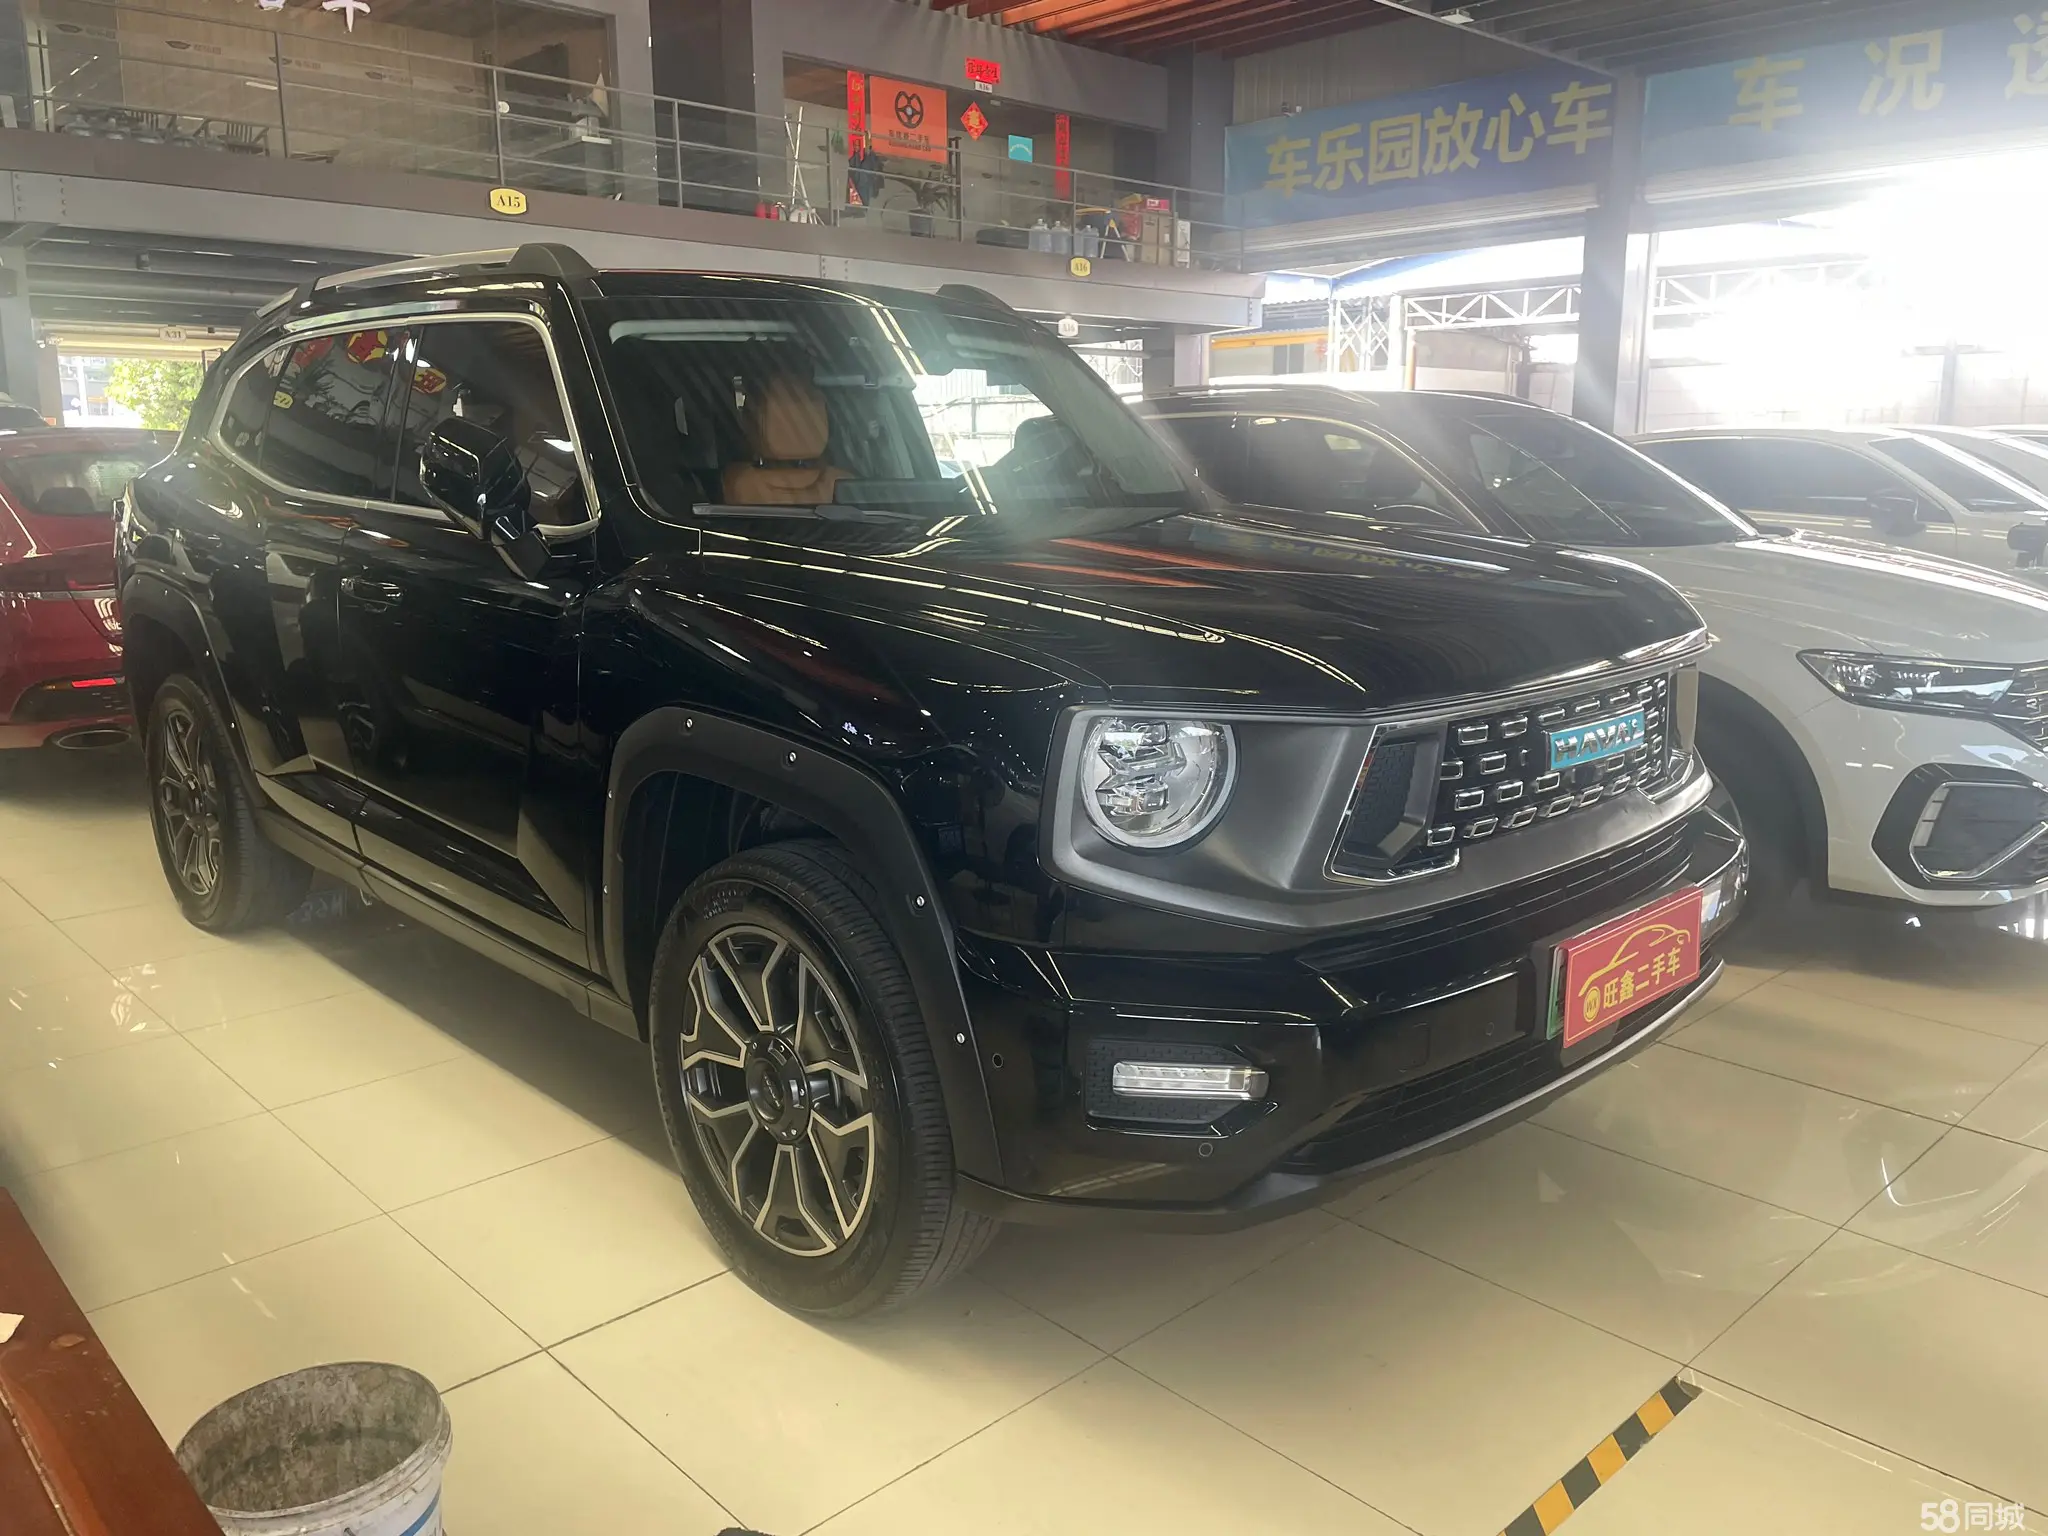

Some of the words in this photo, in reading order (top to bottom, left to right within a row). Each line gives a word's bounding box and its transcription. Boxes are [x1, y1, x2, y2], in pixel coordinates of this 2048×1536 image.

[1263, 80, 1612, 198] 车乐园放心车
[497, 194, 521, 208] A15
[1603, 947, 1681, 1009] 旺鑫二手车
